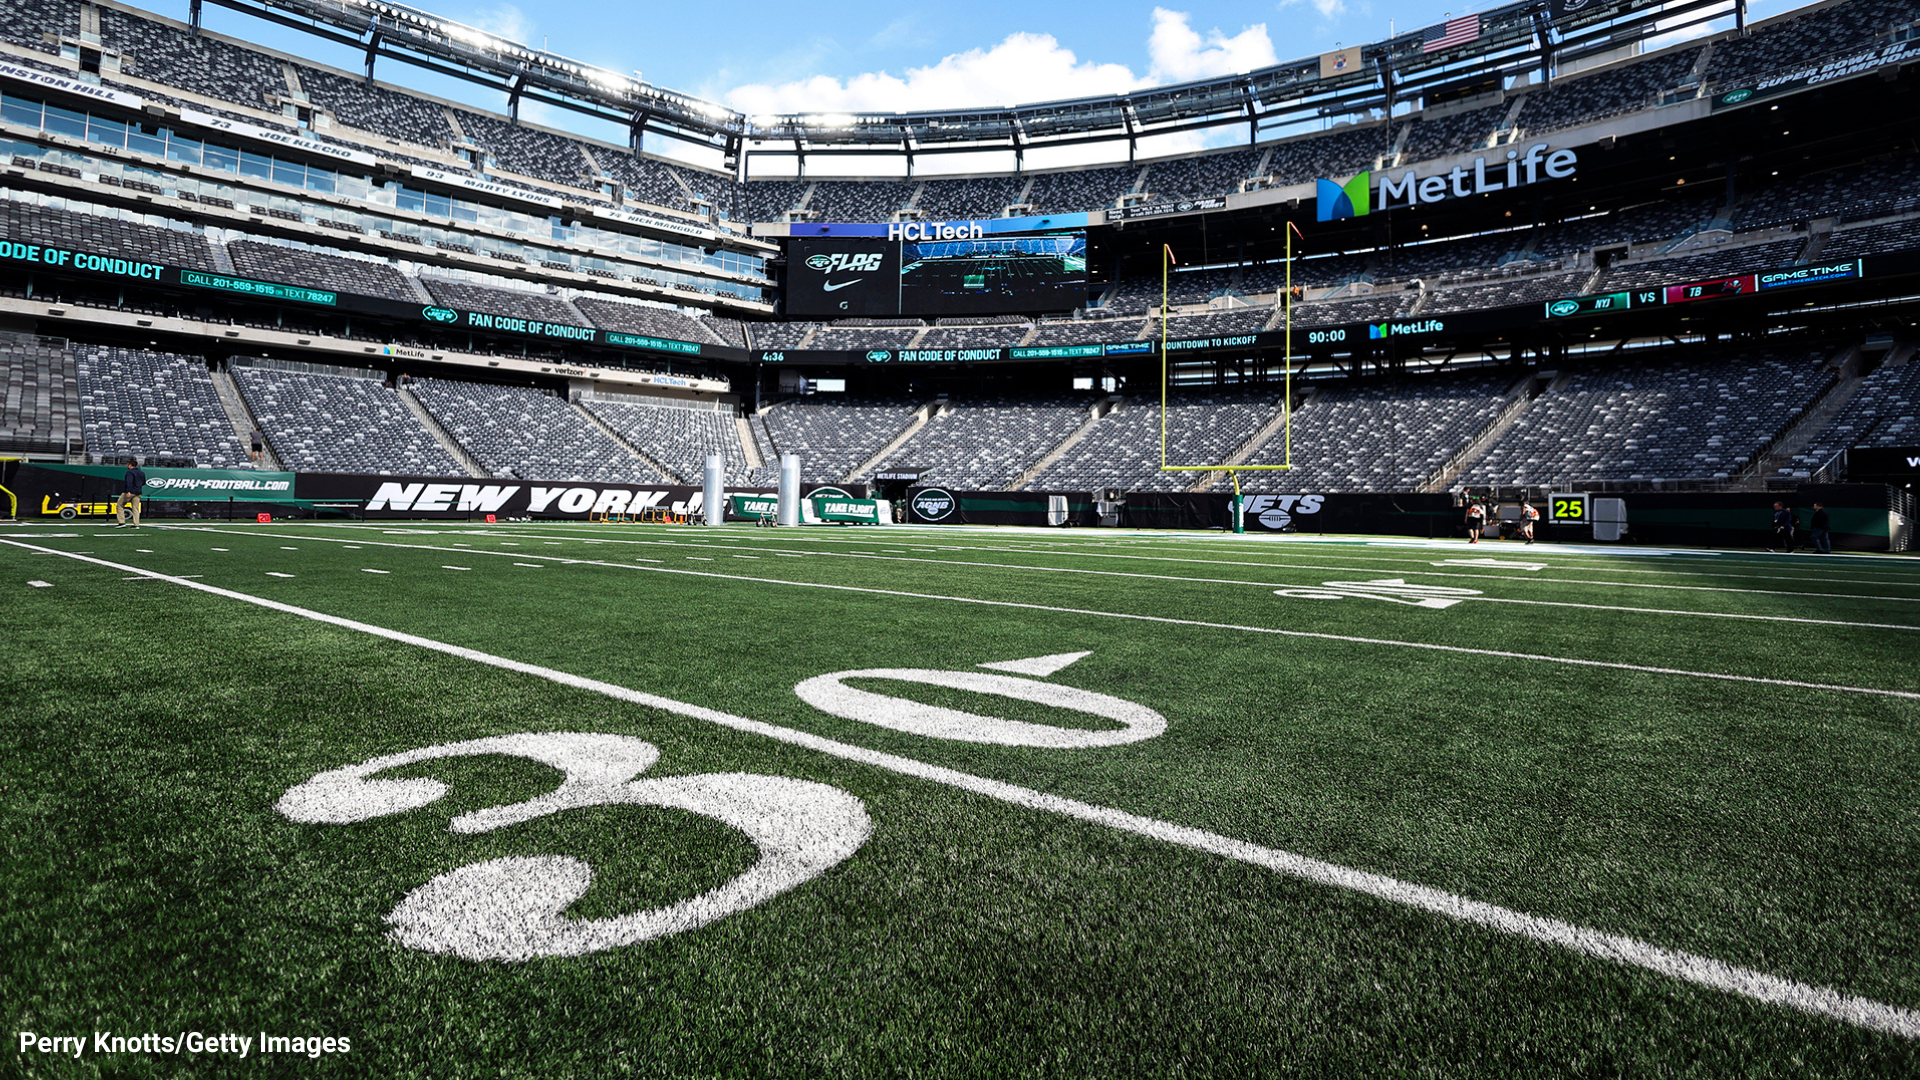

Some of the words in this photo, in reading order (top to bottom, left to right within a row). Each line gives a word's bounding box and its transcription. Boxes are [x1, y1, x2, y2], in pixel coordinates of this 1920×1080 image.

[1757, 68, 1819, 91] SUPER
[1820, 53, 1877, 74] BOWL
[1883, 43, 1907, 56] III
[1807, 47, 1920, 85] CHAMPIONS
[0, 64, 71, 88] NSTON
[73, 83, 115, 100] HILL
[210, 118, 232, 129] 73
[259, 130, 291, 144] JOE
[293, 139, 352, 158] KLECKO
[1378, 143, 1578, 211] MetLife
[425, 170, 445, 180] 93
[463, 179, 510, 194] MARTY
[511, 190, 550, 204] LYONS
[627, 215, 653, 225] NICK
[654, 220, 703, 235] MANGOLD
[888, 221, 983, 241] HCLTech
[0, 241, 41, 262] ODE
[44, 248, 71, 266] OF
[74, 253, 164, 280] CONDUCT
[824, 253, 883, 274] FLAG
[187, 273, 211, 286] CALL
[212, 278, 275, 294] 201-559-1515
[284, 288, 306, 299] TEXT
[306, 292, 334, 303] 78247
[1689, 286, 1702, 297] TB
[1594, 298, 1611, 309] NYJ
[1639, 292, 1656, 303] VS
[468, 312, 493, 328] FAN
[494, 316, 527, 332] CODE
[528, 321, 544, 334] OF
[545, 323, 596, 341] CONDUCT
[1391, 320, 1444, 335] MetLife
[610, 334, 624, 343] CALL
[668, 342, 682, 350] TEXT
[682, 344, 699, 352] 78247
[1212, 338, 1222, 347] TO
[1223, 335, 1257, 346] KICKOFF
[1309, 329, 1346, 343] 90:00
[396, 348, 425, 358] MetLife
[762, 352, 784, 362] 4:36
[898, 350, 917, 362] FAN
[918, 350, 943, 362] CODE
[944, 350, 956, 361] OF
[958, 348, 1001, 362] CONDUCT
[554, 366, 584, 376] verizon
[654, 376, 686, 386] HCLTech
[365, 482, 521, 512] NEW
[526, 487, 669, 514] YORK
[744, 500, 770, 512] TAKE
[916, 501, 949, 509] AGNB
[1228, 495, 1325, 514] JETS
[824, 502, 848, 514] TAKE
[848, 504, 876, 514] FLIGHT
[1555, 500, 1582, 518] 25
[260, 514, 270, 522] 20
